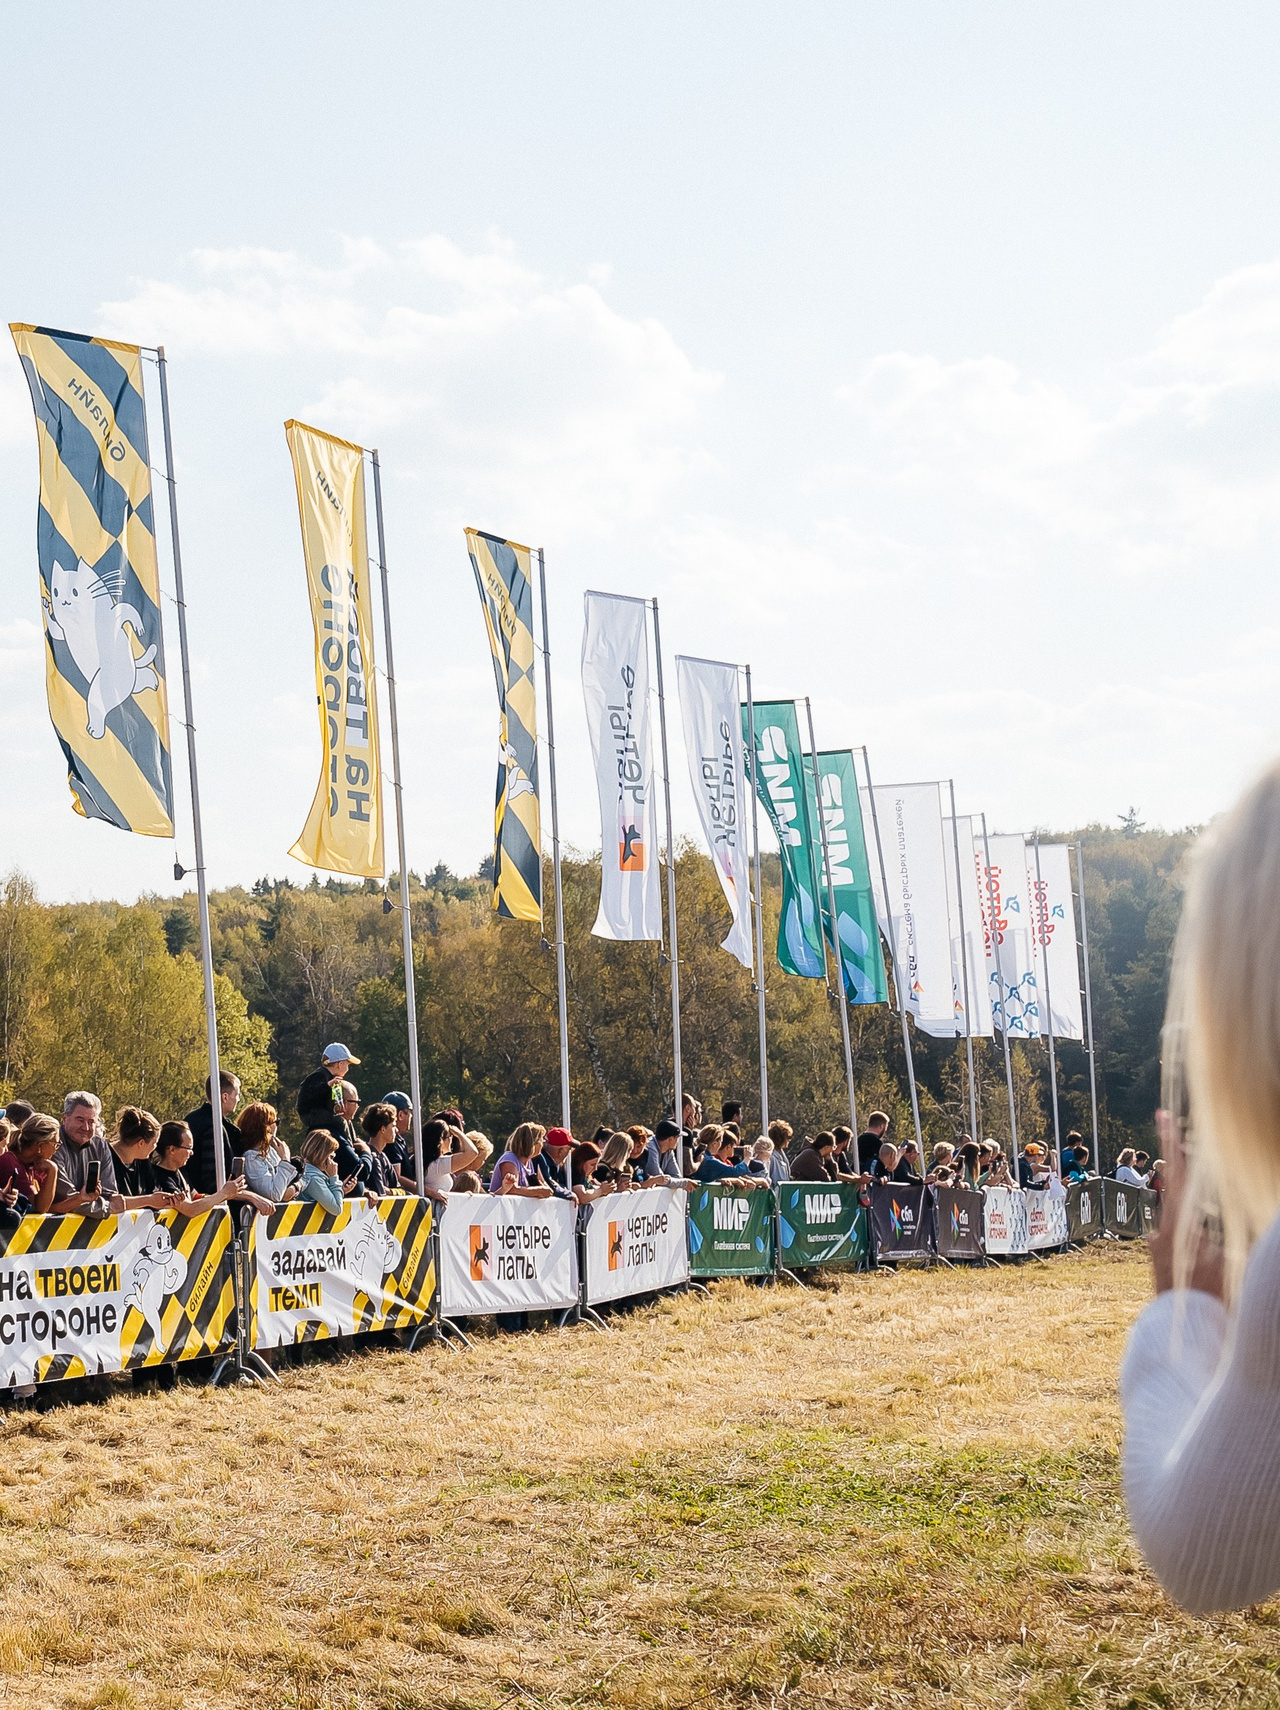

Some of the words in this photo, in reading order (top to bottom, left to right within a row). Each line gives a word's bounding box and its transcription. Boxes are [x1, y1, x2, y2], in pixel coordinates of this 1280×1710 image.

[713, 1197, 750, 1230] МИР
[805, 1193, 842, 1225] МИР
[901, 1205, 914, 1222] сбп
[496, 1224, 551, 1252] четыре
[627, 1212, 668, 1240] четыре
[270, 1239, 347, 1279] задавай
[402, 1246, 421, 1290] билайн
[497, 1255, 538, 1281] лапы
[627, 1242, 657, 1267] лапы
[38, 1254, 118, 1298] твоей
[188, 1260, 215, 1314] билайн
[270, 1283, 321, 1311] темп
[0, 1303, 118, 1350] стороне
